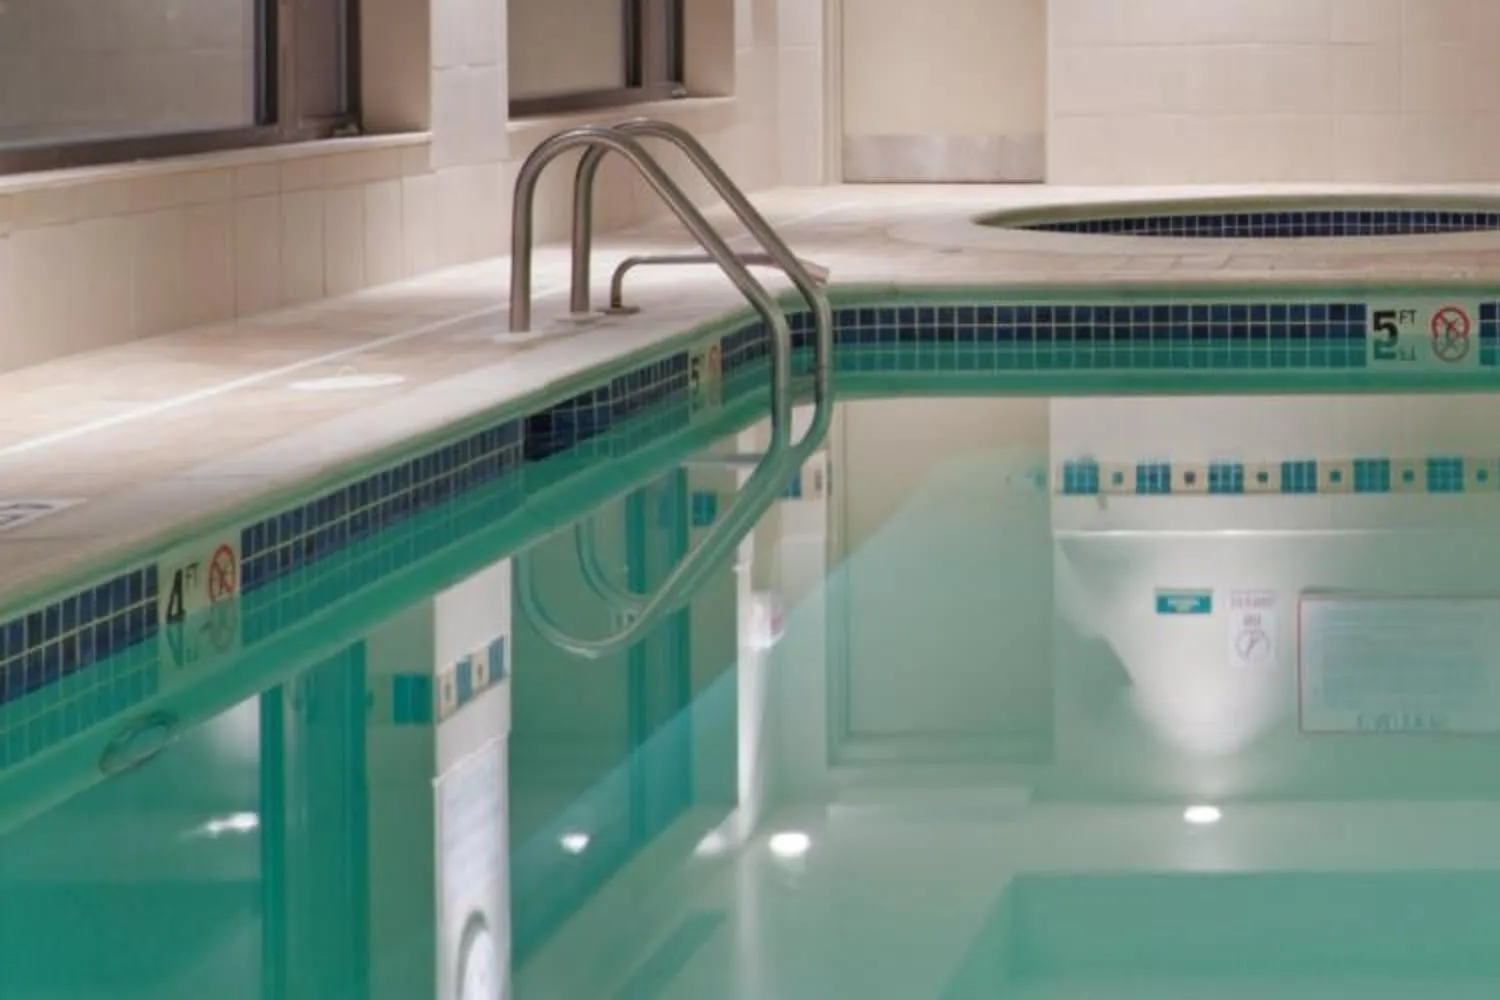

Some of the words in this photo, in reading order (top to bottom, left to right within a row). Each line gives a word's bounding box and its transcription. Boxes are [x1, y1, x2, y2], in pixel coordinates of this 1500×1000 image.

[1373, 309, 1399, 347] 5
[1399, 309, 1417, 325] FT
[166, 568, 186, 623] 4
[185, 561, 200, 590] FT
